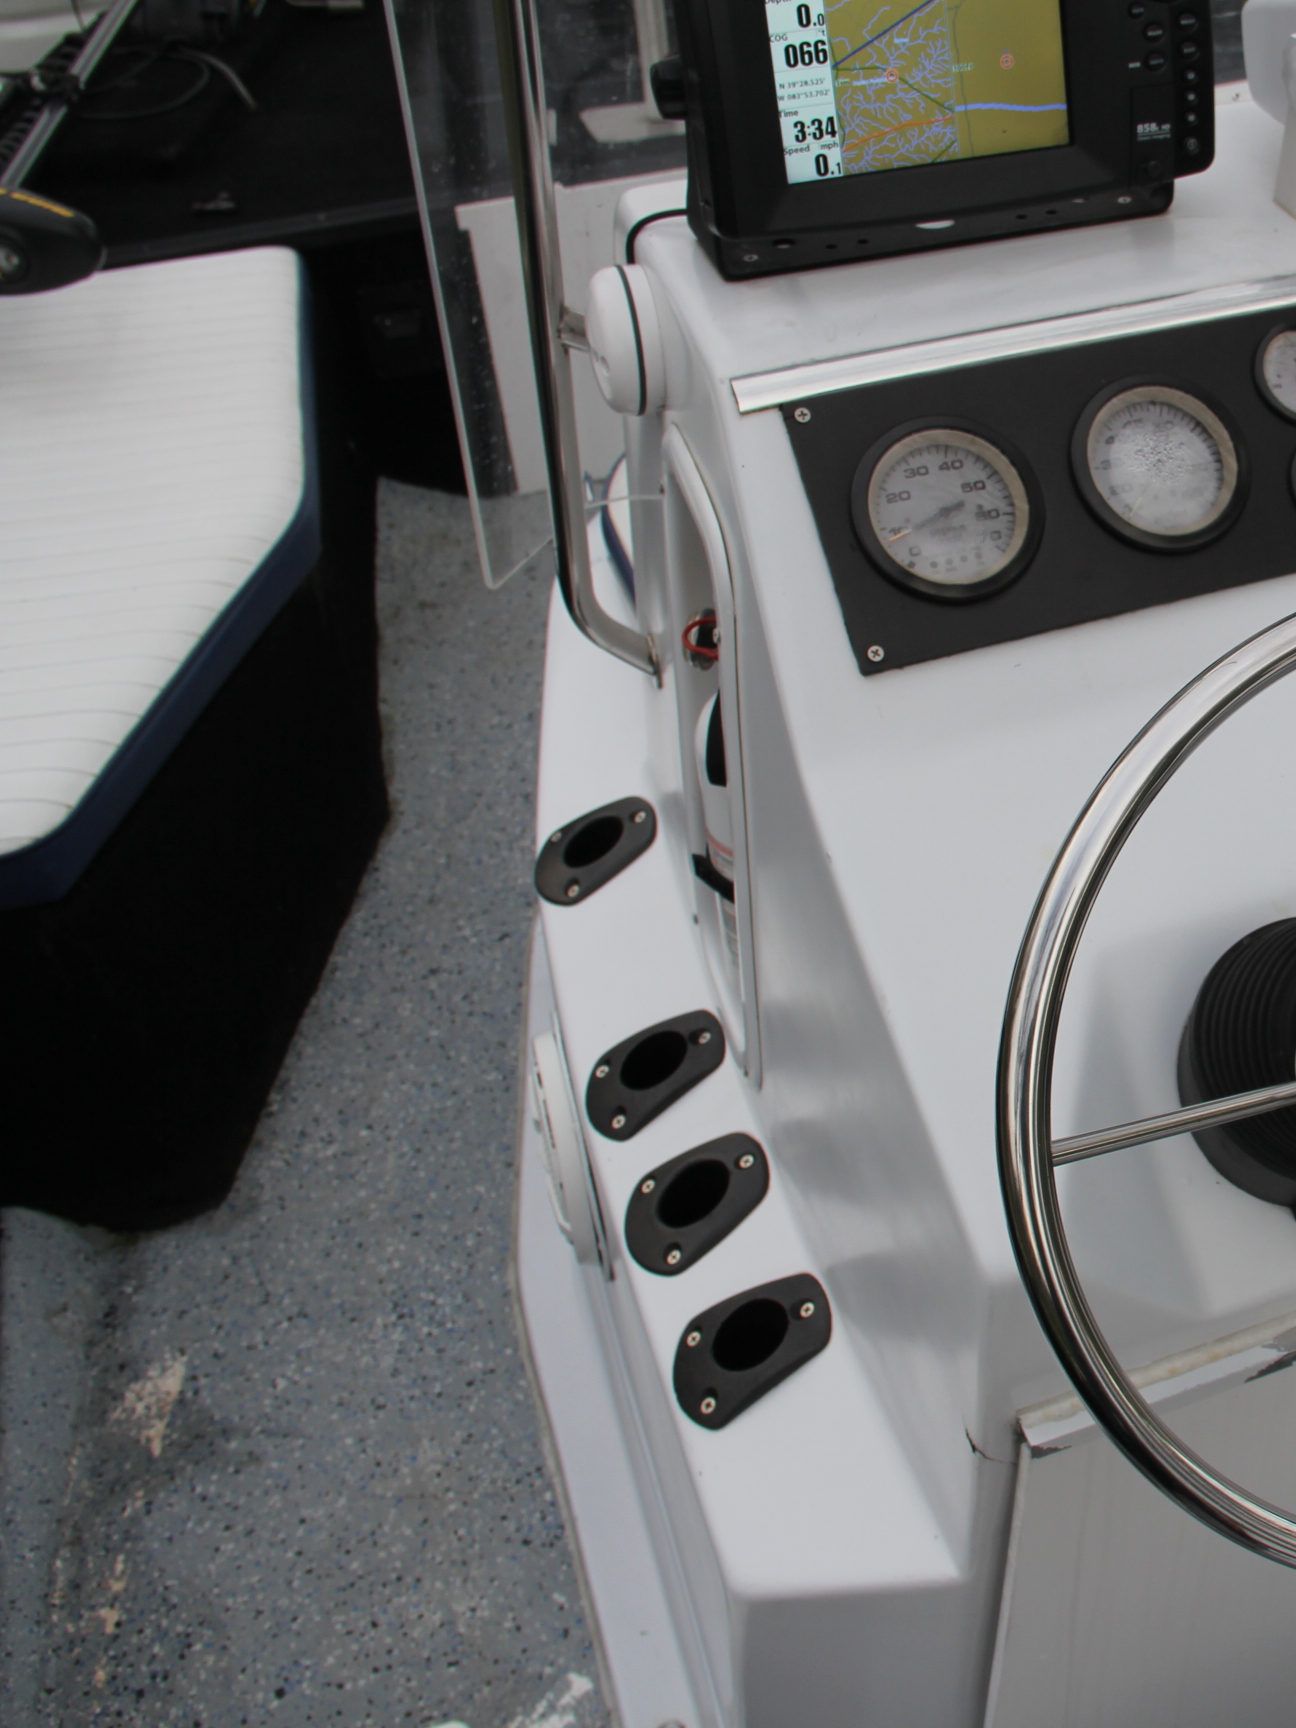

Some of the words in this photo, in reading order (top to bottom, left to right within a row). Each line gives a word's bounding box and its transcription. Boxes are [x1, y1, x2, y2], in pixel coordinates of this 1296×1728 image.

[796, 3, 825, 28] 0.0
[769, 33, 788, 42] COG
[784, 39, 828, 69] 066
[779, 110, 798, 118] Time
[793, 116, 837, 143] 3:34
[783, 145, 810, 156] Speed
[821, 141, 839, 151] mph
[815, 153, 841, 177] 0.1
[904, 465, 929, 479] 30
[938, 459, 963, 472] 40
[961, 480, 986, 494] 50
[886, 490, 911, 504] 20
